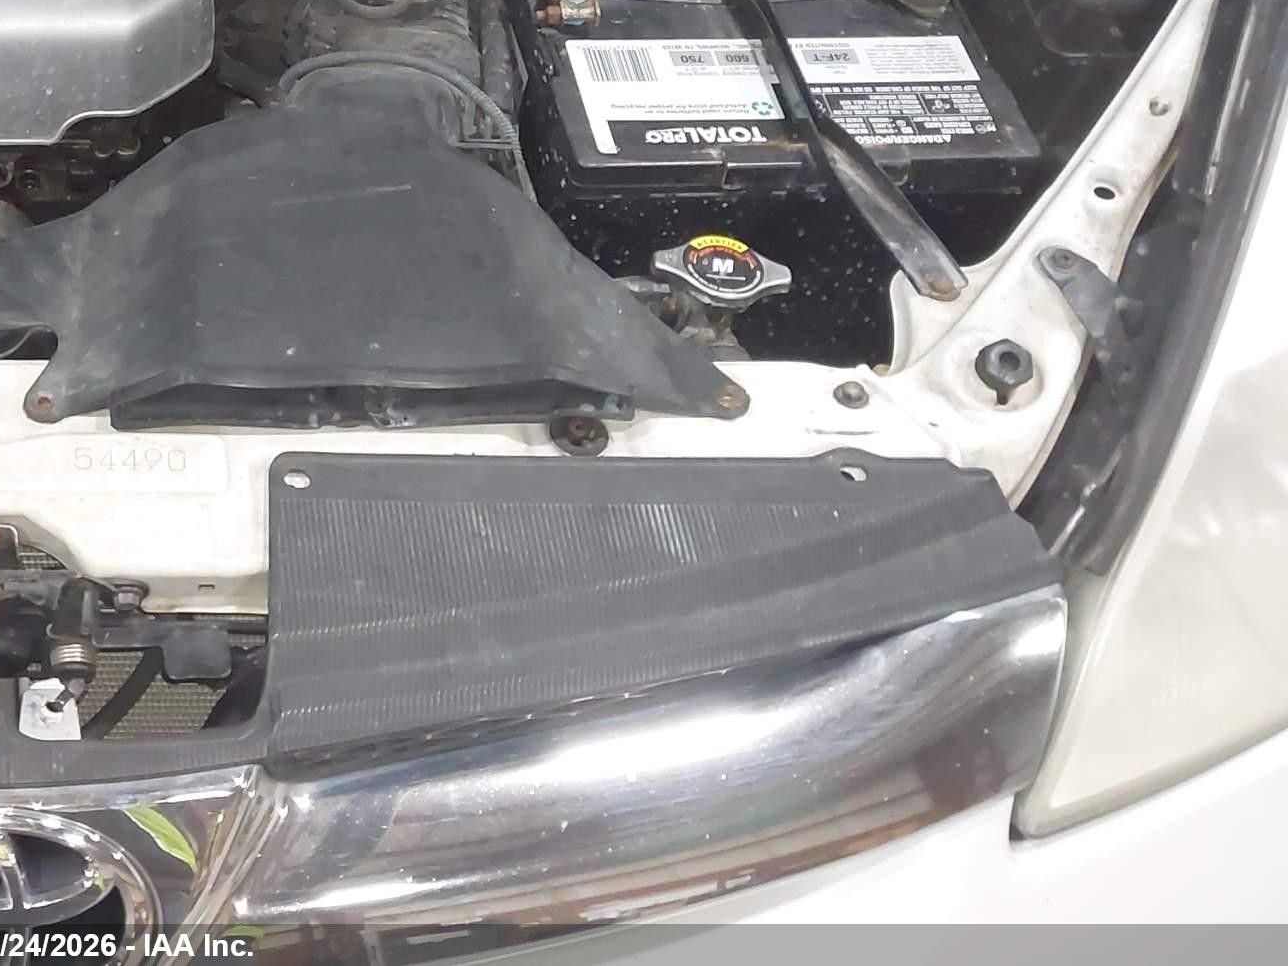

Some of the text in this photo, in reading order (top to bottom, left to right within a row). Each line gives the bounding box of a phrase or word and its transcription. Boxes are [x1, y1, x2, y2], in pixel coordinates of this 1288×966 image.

[680, 55, 704, 63] 750
[813, 53, 850, 62] 24F-T
[645, 125, 768, 144] TOTALPRO
[854, 134, 944, 145] DANGER/POISO
